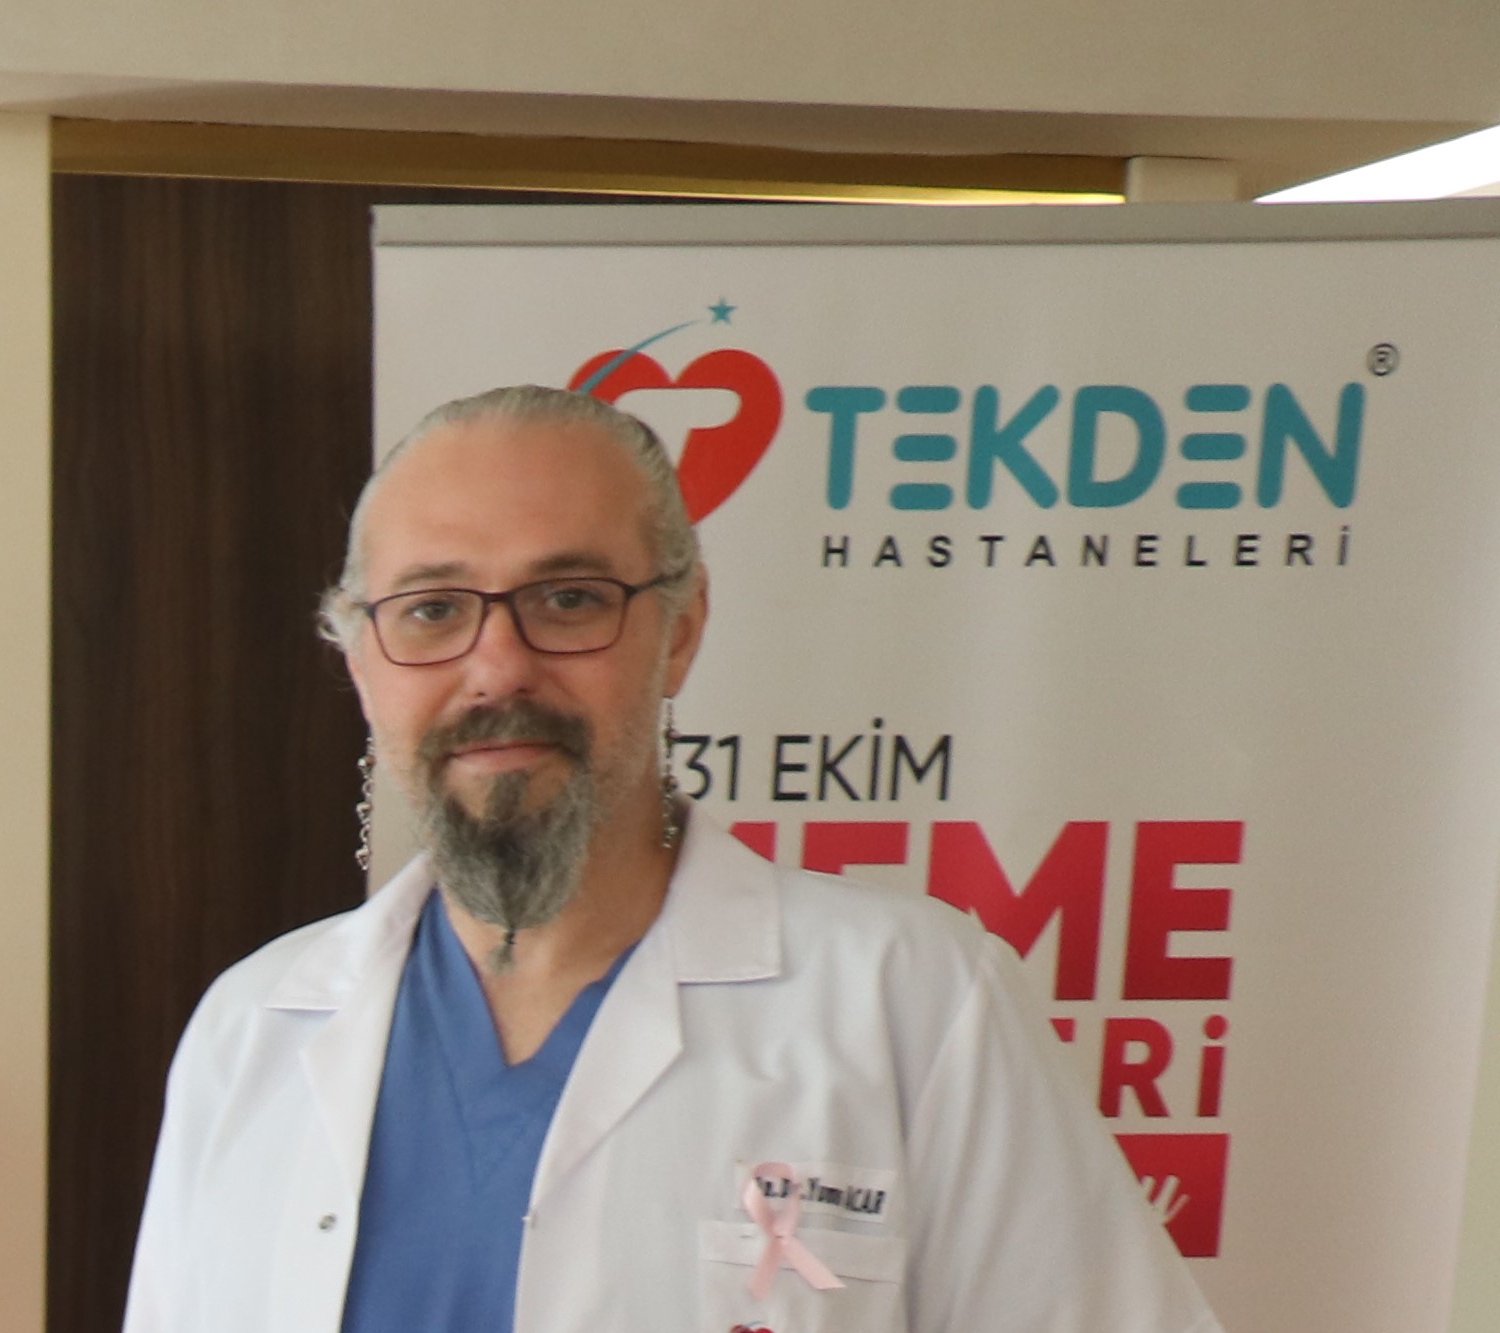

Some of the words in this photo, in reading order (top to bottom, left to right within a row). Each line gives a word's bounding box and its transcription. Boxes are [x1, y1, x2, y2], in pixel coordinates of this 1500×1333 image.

[805, 381, 1366, 511] TEKDEN
[822, 525, 1349, 569] HASTANELERİ
[771, 717, 952, 802] EKİM
